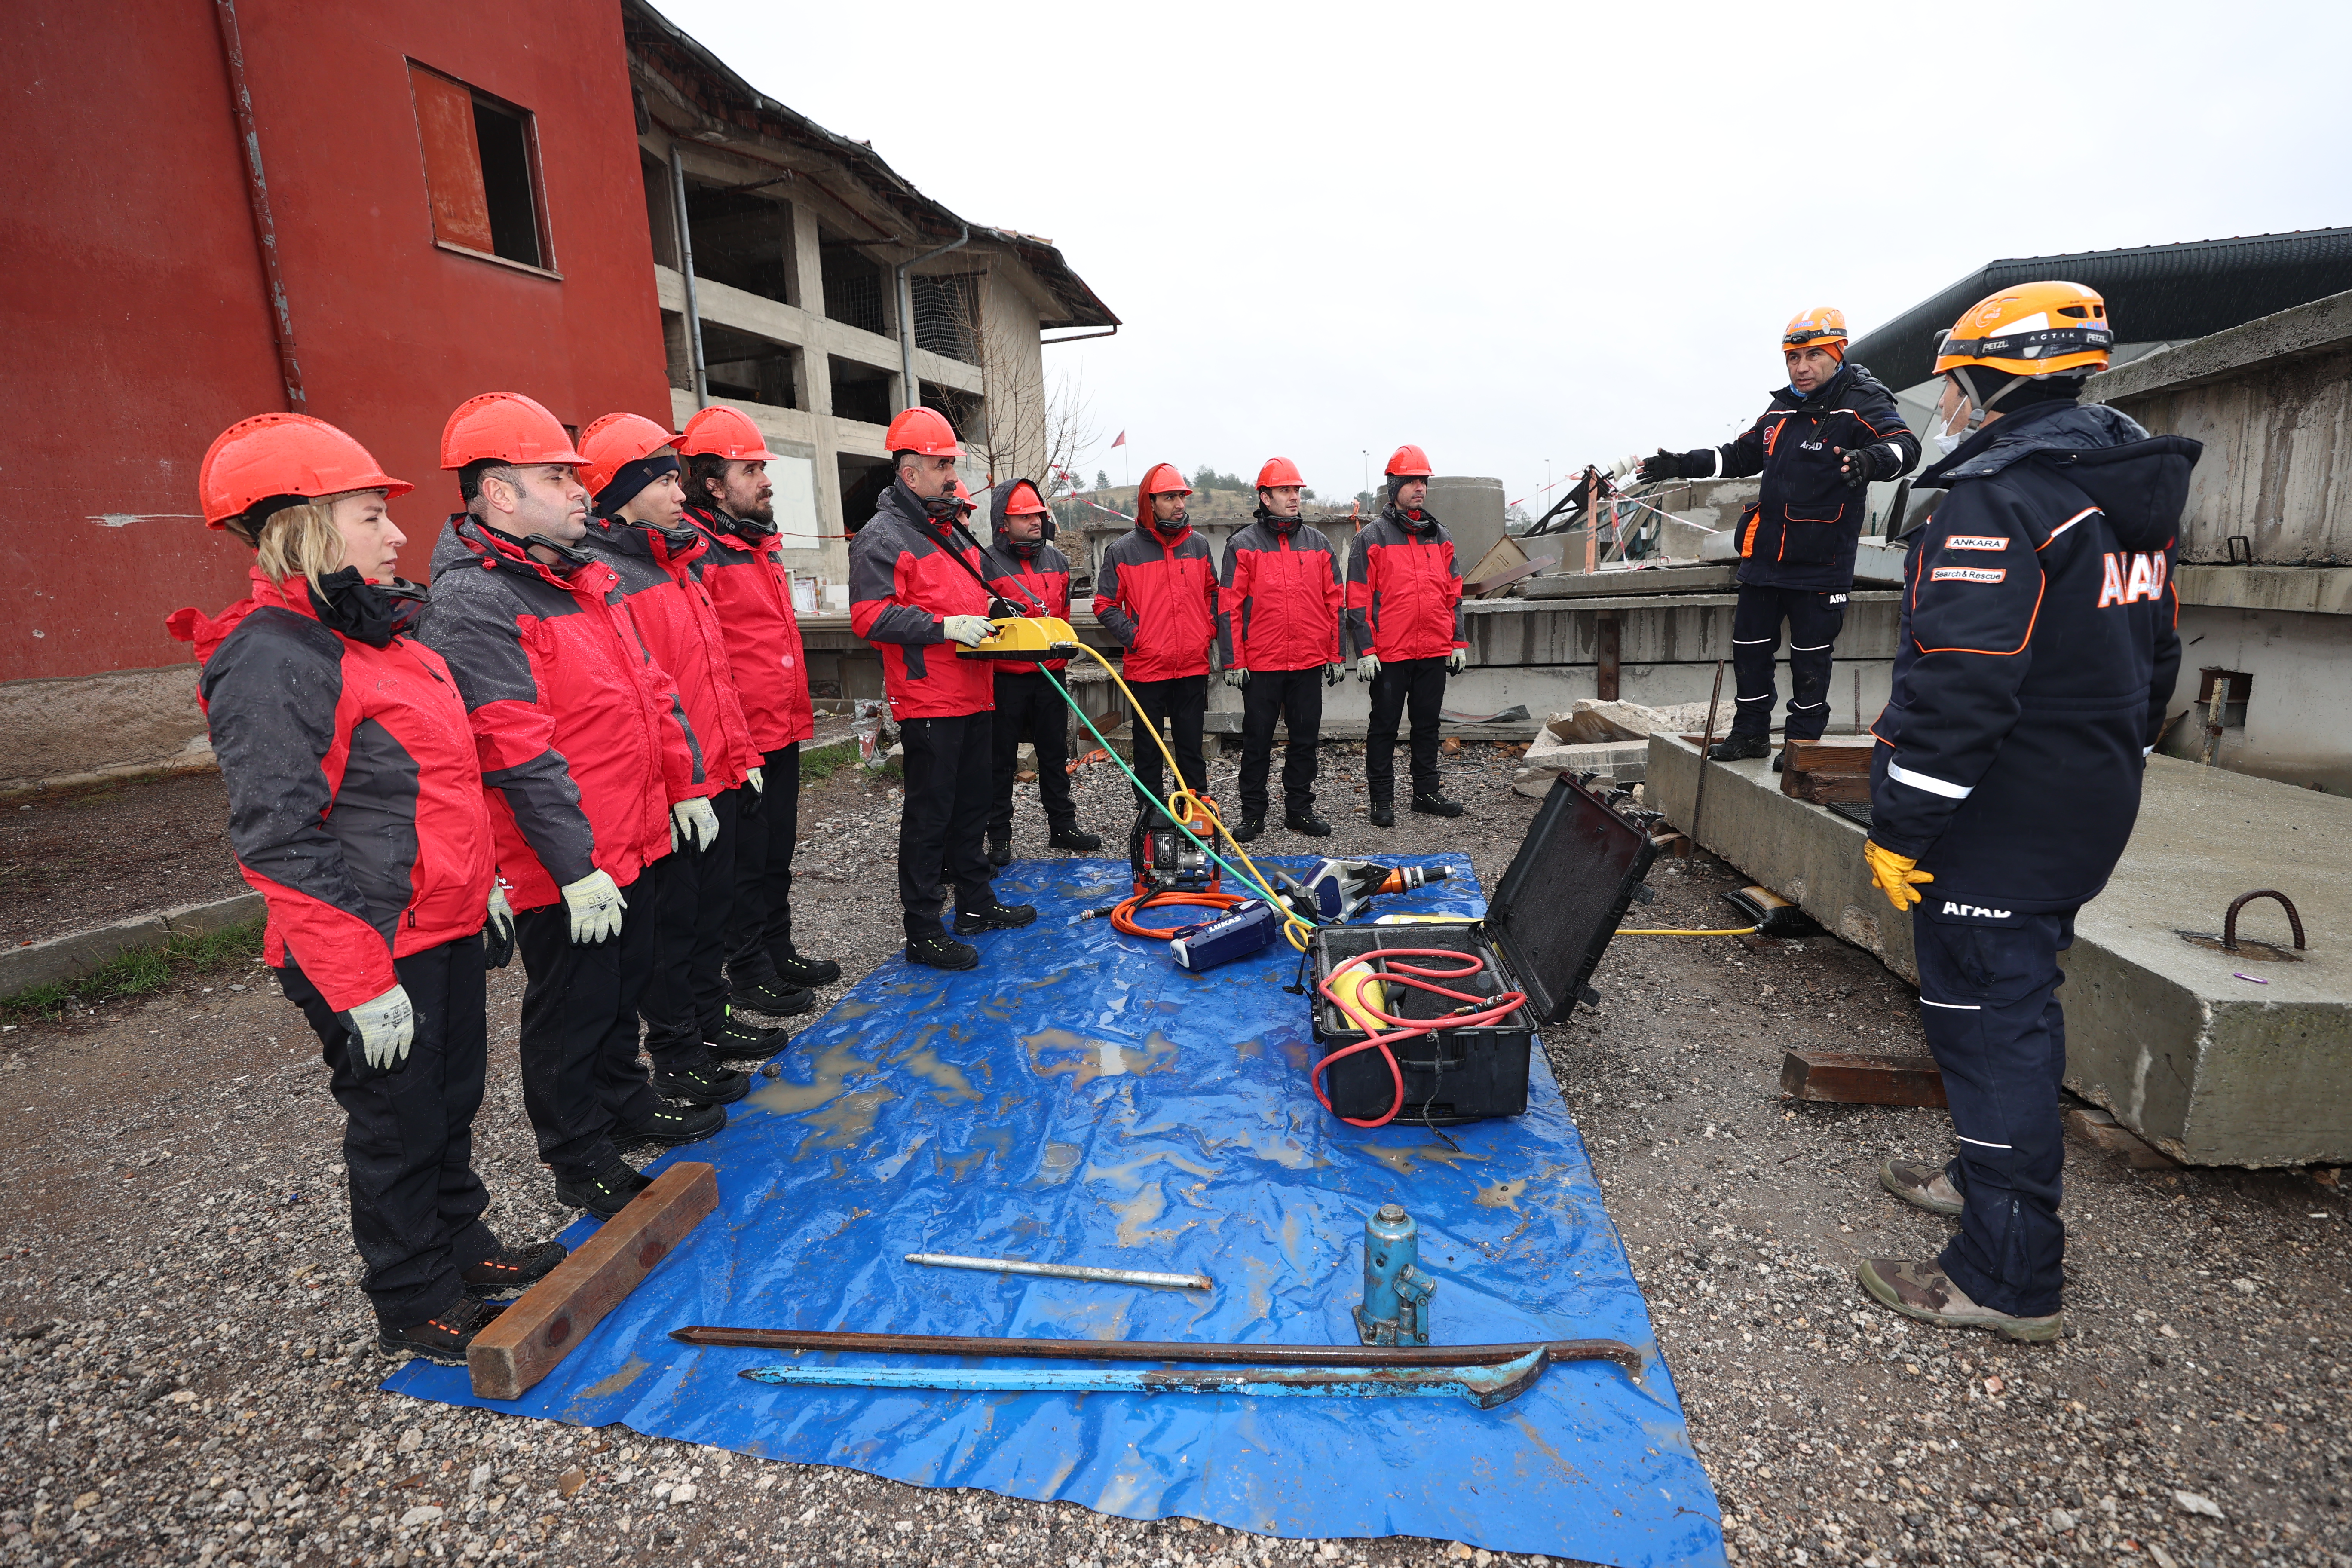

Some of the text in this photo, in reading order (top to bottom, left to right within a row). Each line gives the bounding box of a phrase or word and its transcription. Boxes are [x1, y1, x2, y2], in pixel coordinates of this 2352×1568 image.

[1793, 320, 1814, 329] AFAD
[2029, 332, 2075, 342] ACTIK
[2086, 333, 2108, 343] PETZL
[1982, 340, 2009, 354] PETZL
[1952, 539, 2000, 547] ANKARA
[1969, 571, 2001, 580] Rescue
[1830, 593, 1847, 604] AFAD
[1208, 916, 1242, 932] LUKAS
